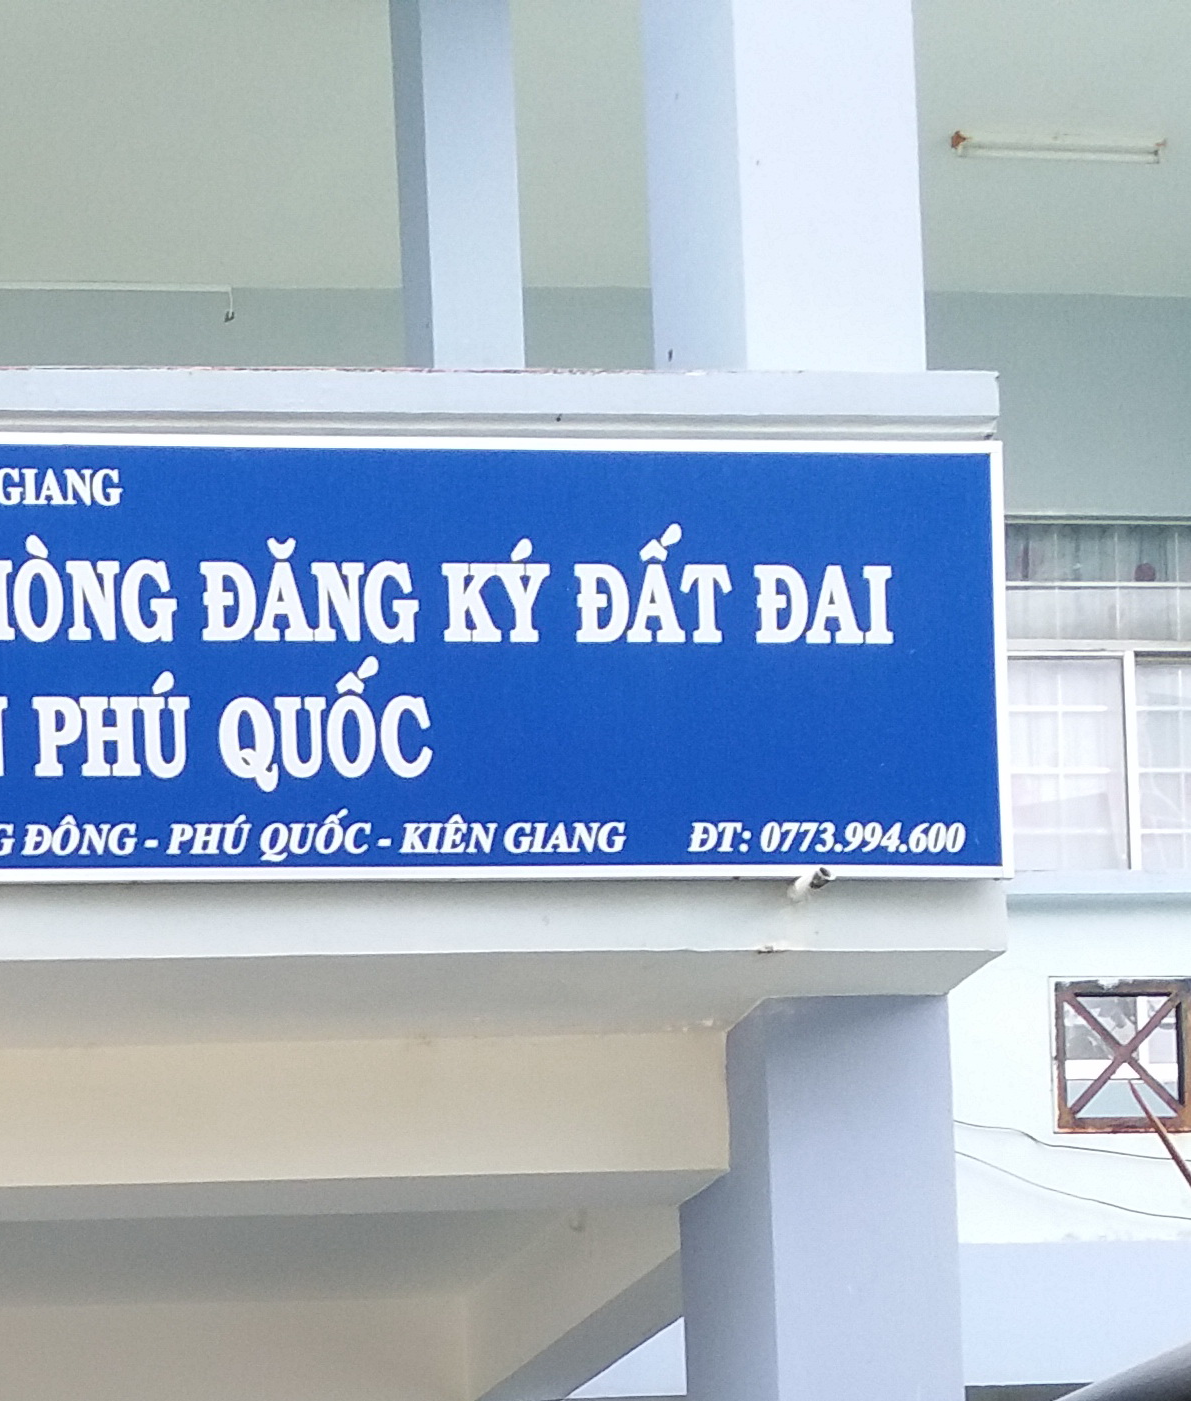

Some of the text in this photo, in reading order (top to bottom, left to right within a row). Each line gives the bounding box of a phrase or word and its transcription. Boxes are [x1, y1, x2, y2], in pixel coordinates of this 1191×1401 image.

[199, 537, 421, 645] ĐĂNG
[441, 538, 551, 643] KÝ
[573, 523, 733, 644] ĐẤT
[753, 564, 894, 645] ĐAI
[31, 670, 191, 779] PHÚ
[218, 655, 434, 793] QUỐC
[21, 814, 138, 856] ĐÔNG
[143, 839, 159, 848] -
[166, 814, 252, 855] PHÚ
[259, 808, 372, 863] QUỐC
[377, 838, 392, 847] -
[399, 813, 498, 854] KIÊN
[503, 821, 627, 855] GIANG
[687, 821, 966, 854] ĐT: 0773.994.600
